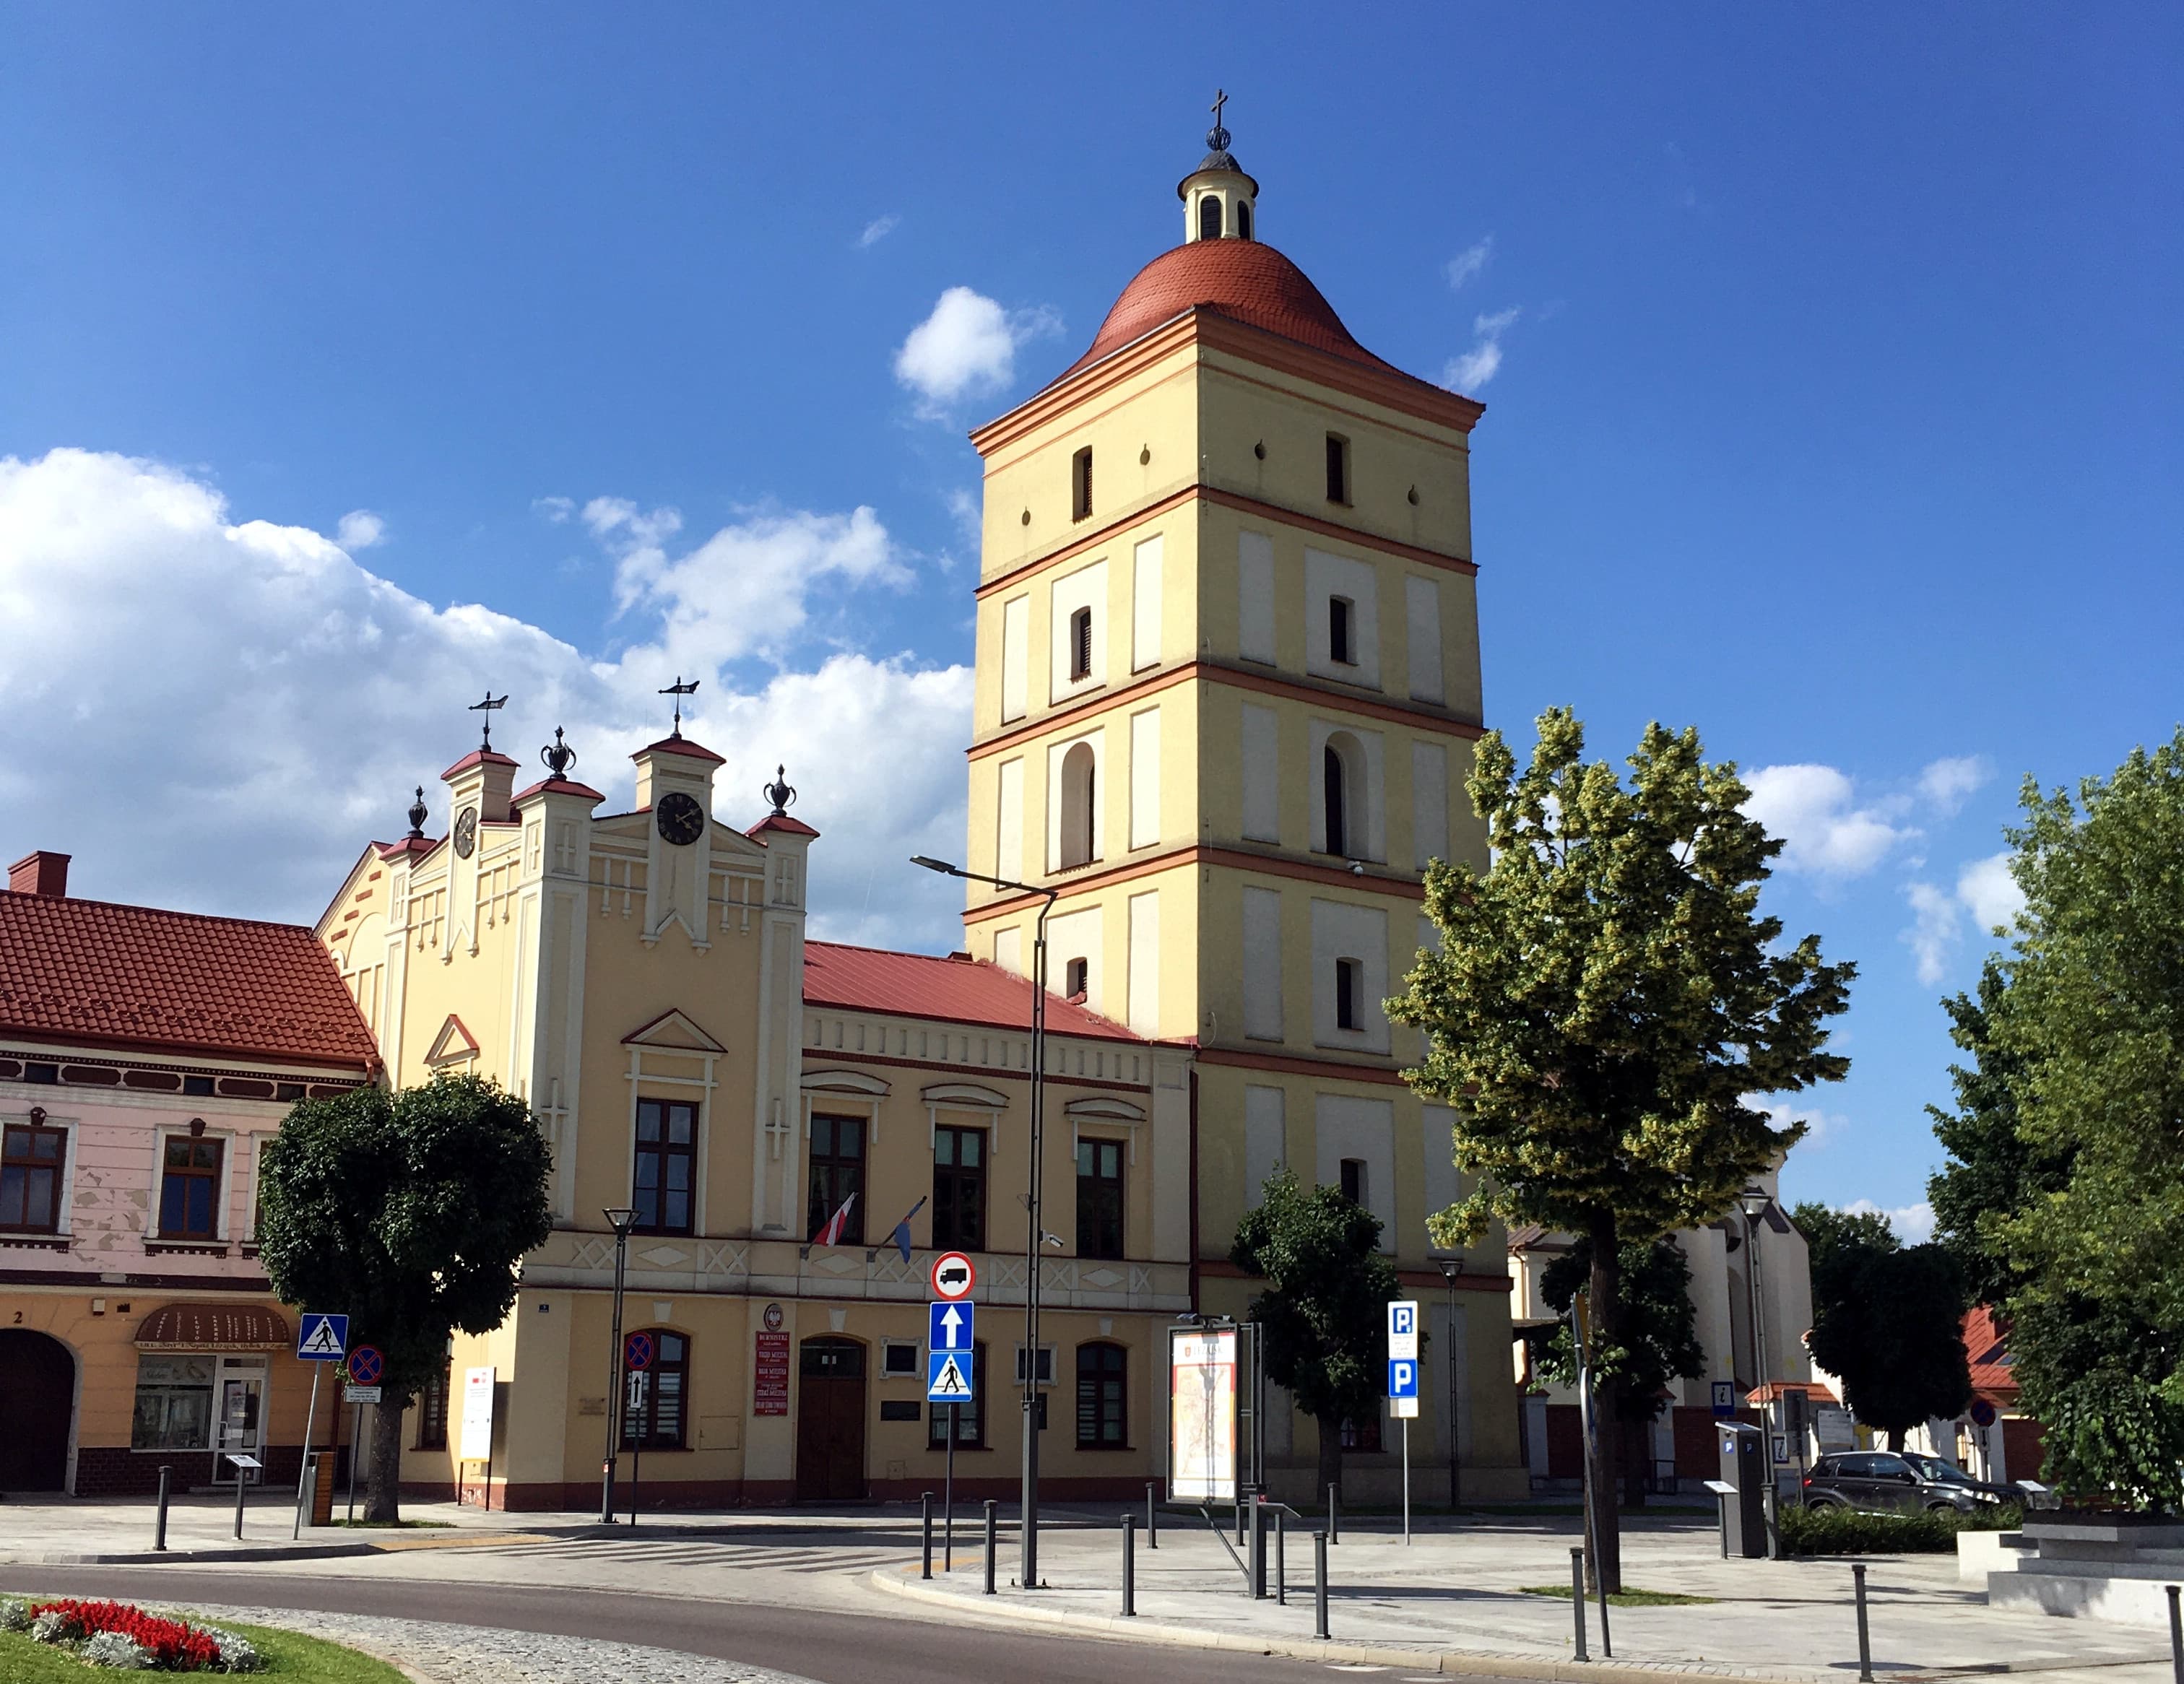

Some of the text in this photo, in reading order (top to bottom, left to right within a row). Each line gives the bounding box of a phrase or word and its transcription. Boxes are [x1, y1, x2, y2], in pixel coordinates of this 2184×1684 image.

[14, 1311, 22, 1324] 2
[1397, 1309, 1410, 1331] P
[1395, 1363, 1411, 1393] P
[1725, 1442, 1732, 1452] P
